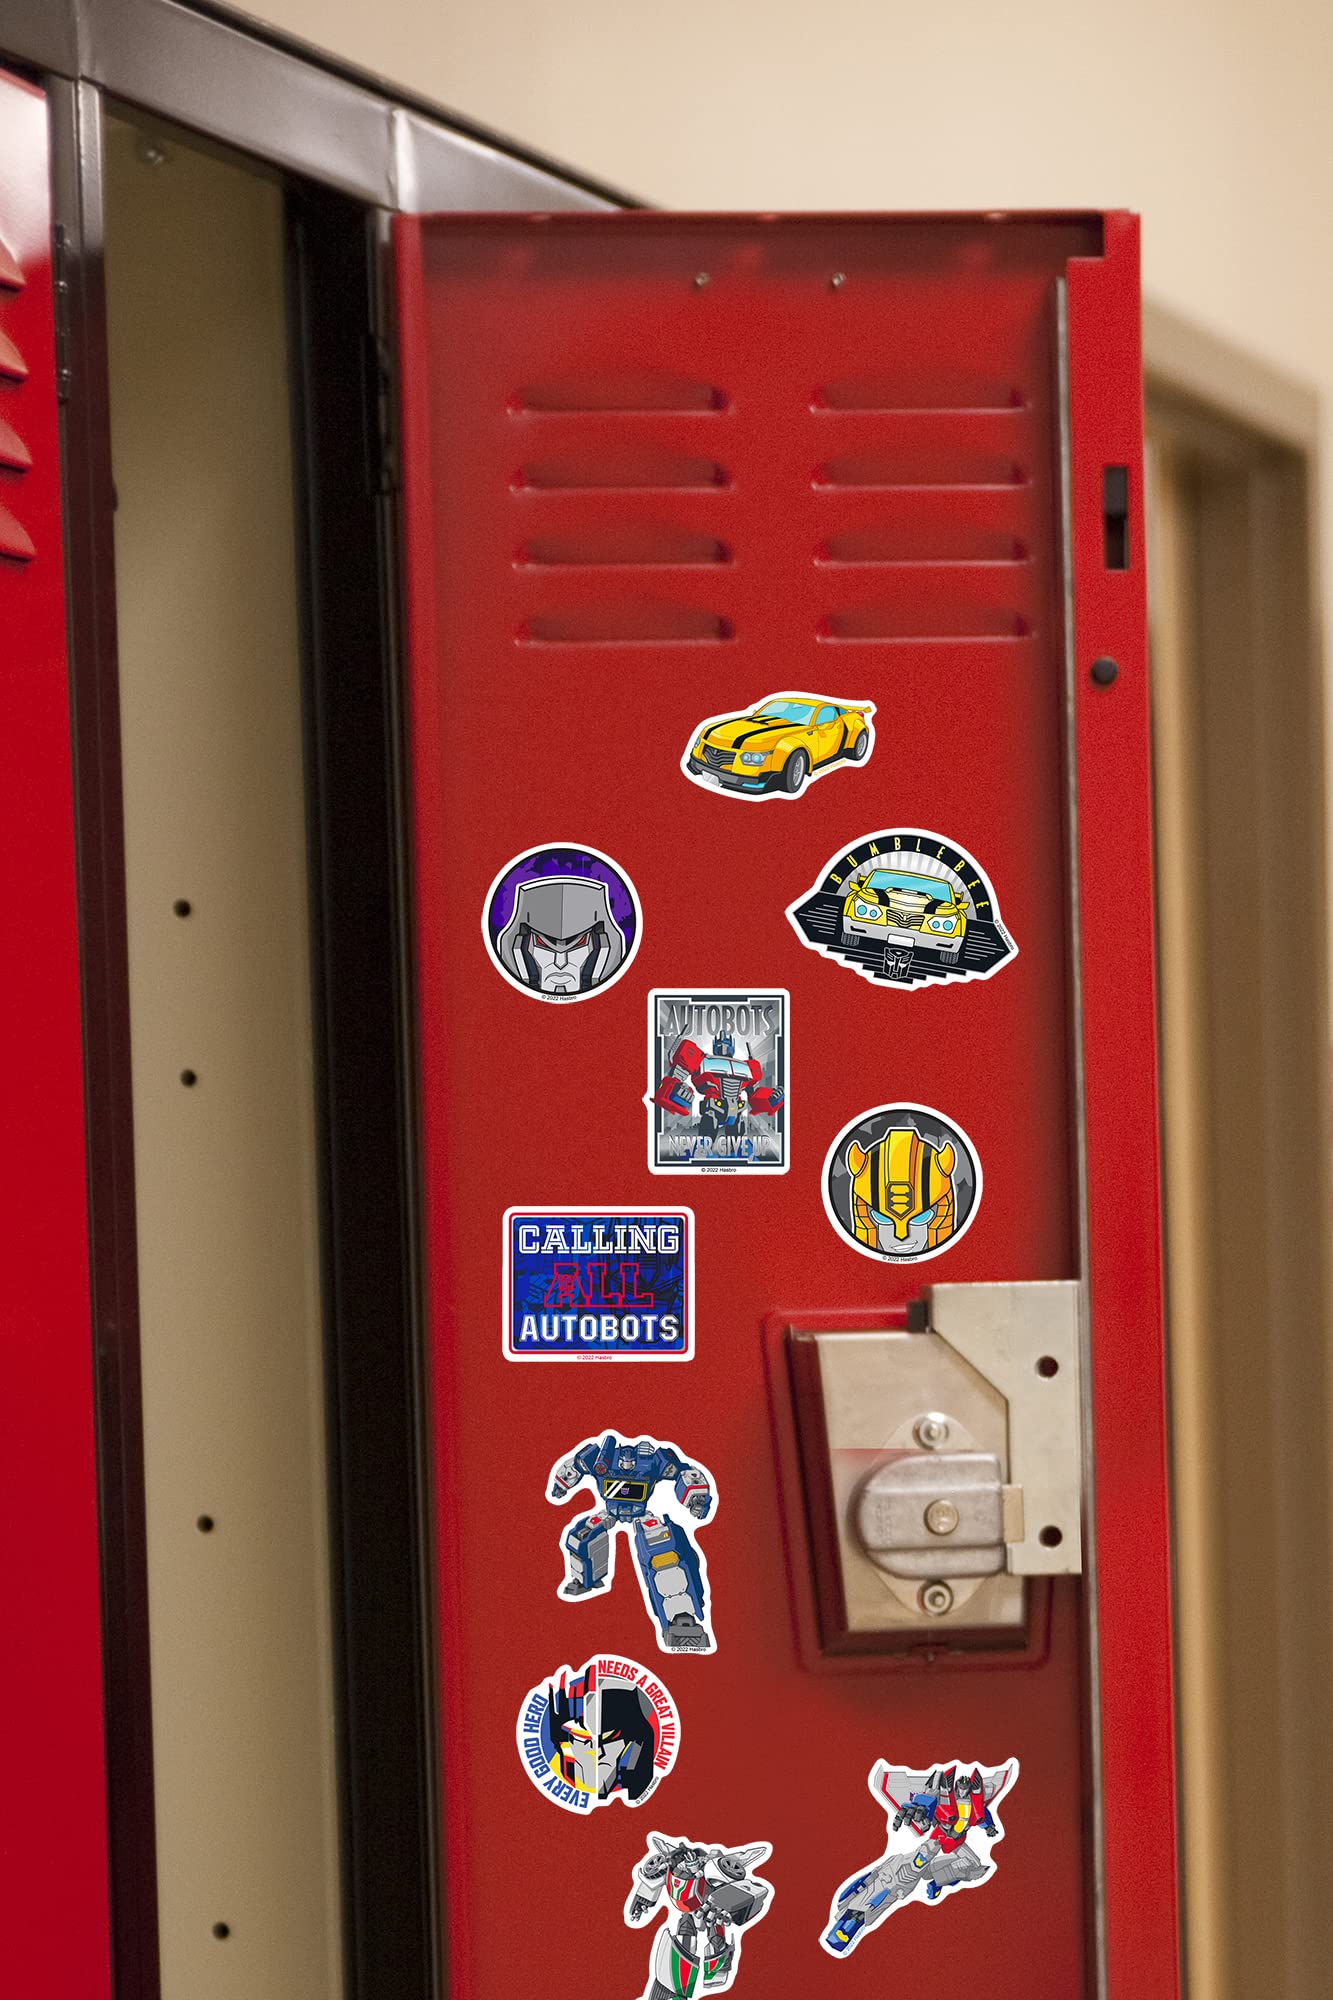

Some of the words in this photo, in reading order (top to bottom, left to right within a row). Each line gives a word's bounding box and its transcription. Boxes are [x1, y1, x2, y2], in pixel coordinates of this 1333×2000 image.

[829, 836, 990, 910] BUMBLEBEE
[664, 1004, 776, 1037] AUTOBOTS
[668, 1134, 713, 1158] NEVER
[717, 1134, 750, 1158] GIVE
[752, 1135, 772, 1158] UP
[518, 1224, 680, 1254] CALLING
[543, 1262, 655, 1308] ALL
[519, 1313, 680, 1342] AUTOBOTS
[598, 1659, 639, 1681] NEEDS
[636, 1674, 649, 1688] A
[523, 1693, 549, 1733] HERO
[644, 1682, 674, 1720] GREAT
[523, 1737, 551, 1779] GOOD
[653, 1721, 676, 1771] VILLAIN
[542, 1775, 591, 1809] EVERY
